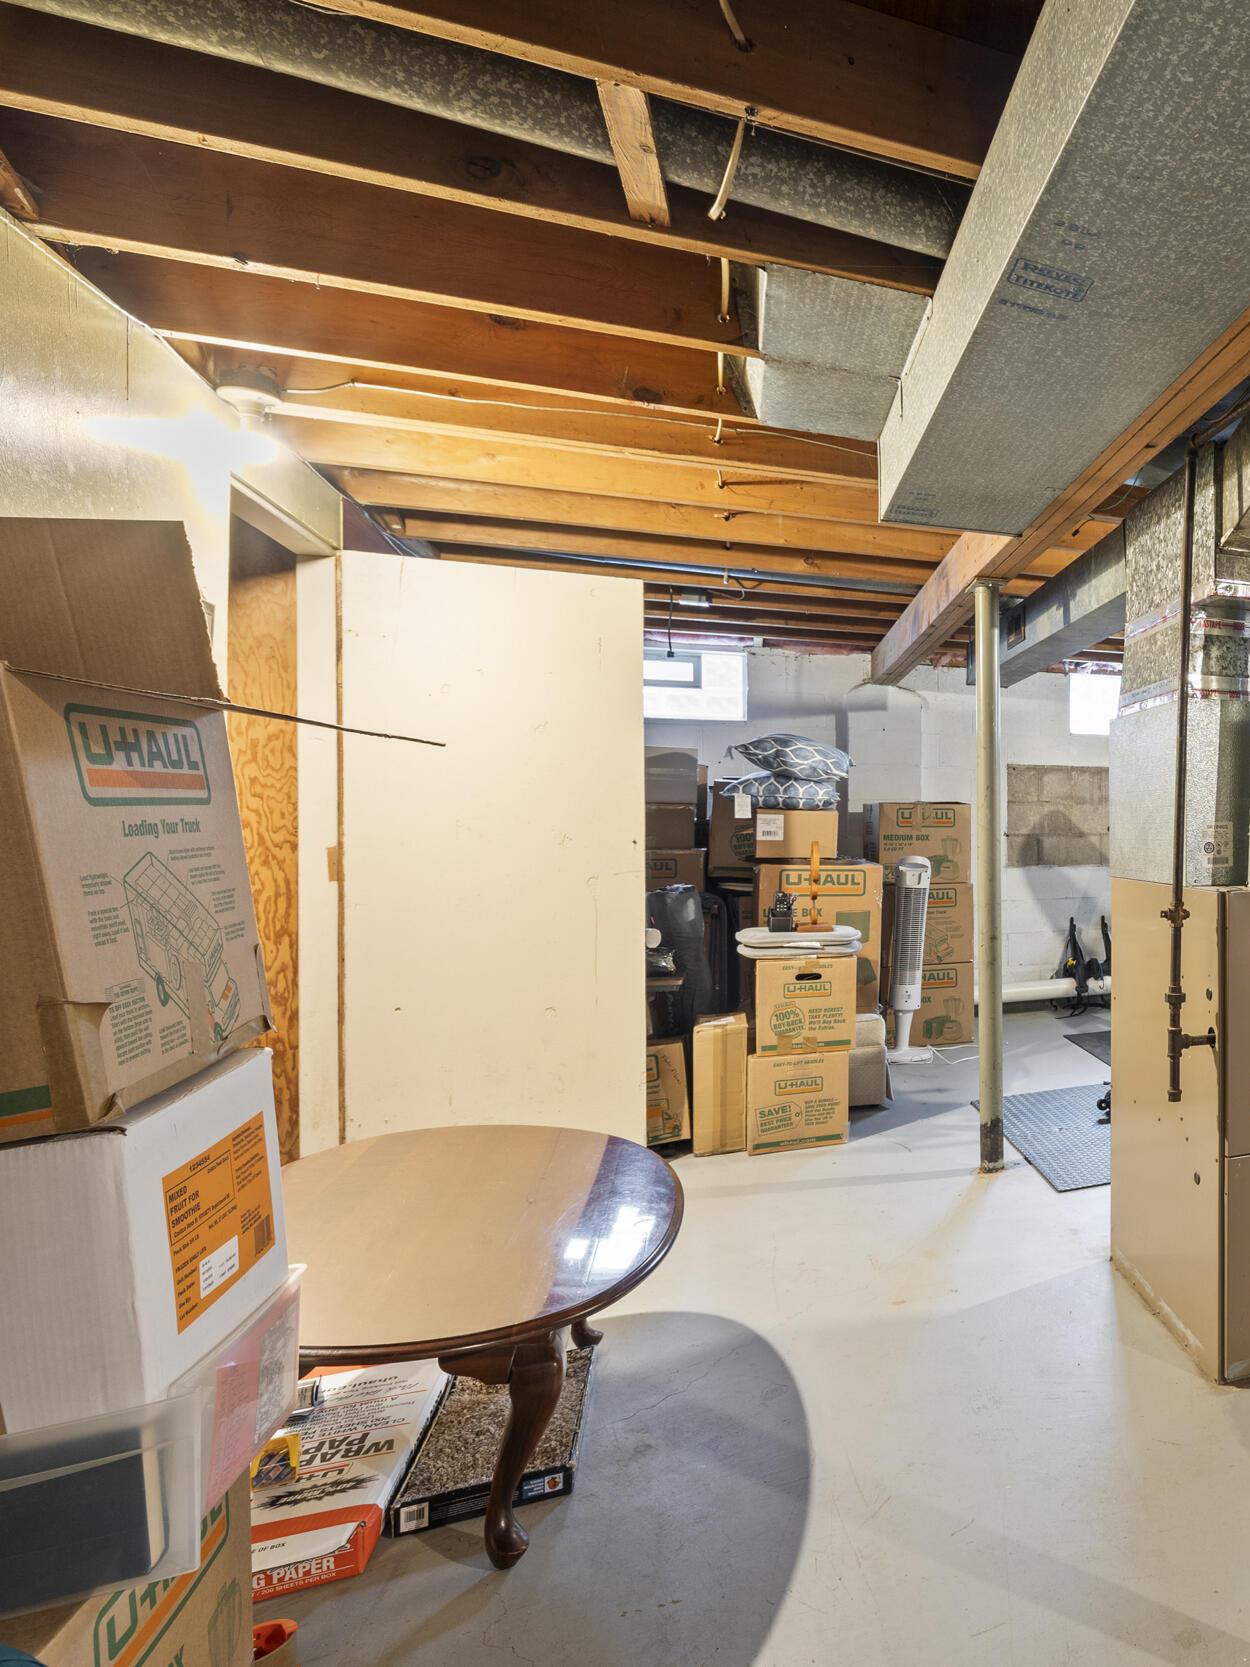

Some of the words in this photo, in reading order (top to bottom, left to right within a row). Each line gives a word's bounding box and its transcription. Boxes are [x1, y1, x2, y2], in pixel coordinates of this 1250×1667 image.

[78, 722, 200, 771] U-HAUL
[122, 820, 159, 838] Loading
[160, 818, 179, 834] Your
[181, 818, 201, 832] Truck
[928, 891, 953, 901] AUL
[801, 909, 822, 918] BX
[787, 984, 829, 993] U-HAUL
[774, 1009, 799, 1022] 100%
[778, 1080, 820, 1090] U-HAUL
[759, 1105, 791, 1119] SAVE!
[168, 1186, 188, 1203] MIXED
[169, 1199, 187, 1217] FRUIT
[188, 1190, 200, 1205] FOR
[171, 1202, 201, 1229] SMOOTHIE
[318, 1376, 399, 1392] uhaul.co
[359, 1416, 406, 1430] CLEAN,
[368, 1414, 391, 1423] 200
[315, 1425, 358, 1437] WHITE
[318, 1419, 369, 1433] SHEETS
[301, 1431, 370, 1456] PAP
[299, 1438, 396, 1467] WRAP
[258, 1544, 269, 1552] OF
[272, 1556, 335, 1584] PAPER
[276, 1580, 303, 1591] SHEETS
